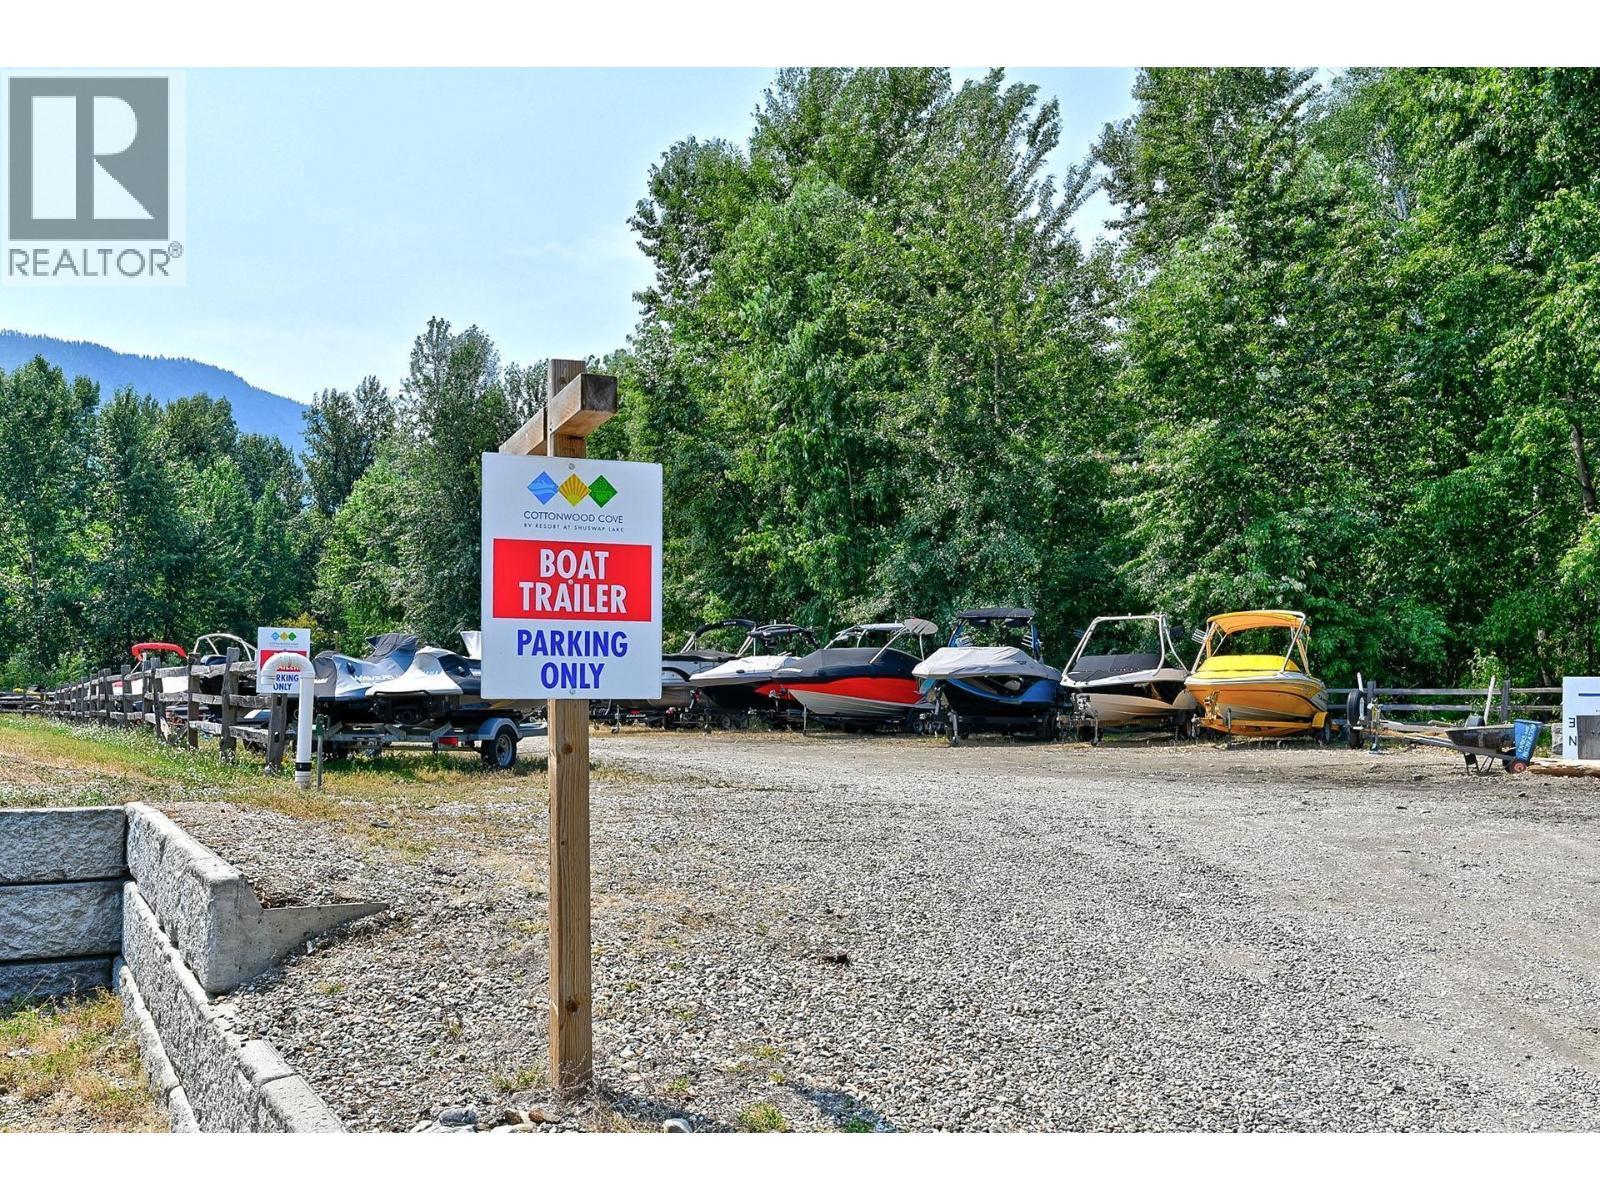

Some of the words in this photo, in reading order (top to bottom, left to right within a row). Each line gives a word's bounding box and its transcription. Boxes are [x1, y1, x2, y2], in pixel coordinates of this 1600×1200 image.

[523, 510, 595, 522] COTTONWOOD
[597, 514, 624, 524] COVE
[539, 548, 609, 580] BOAT
[518, 581, 628, 614] TRAILER
[517, 629, 629, 658] PARKING
[540, 662, 605, 690] ONLY
